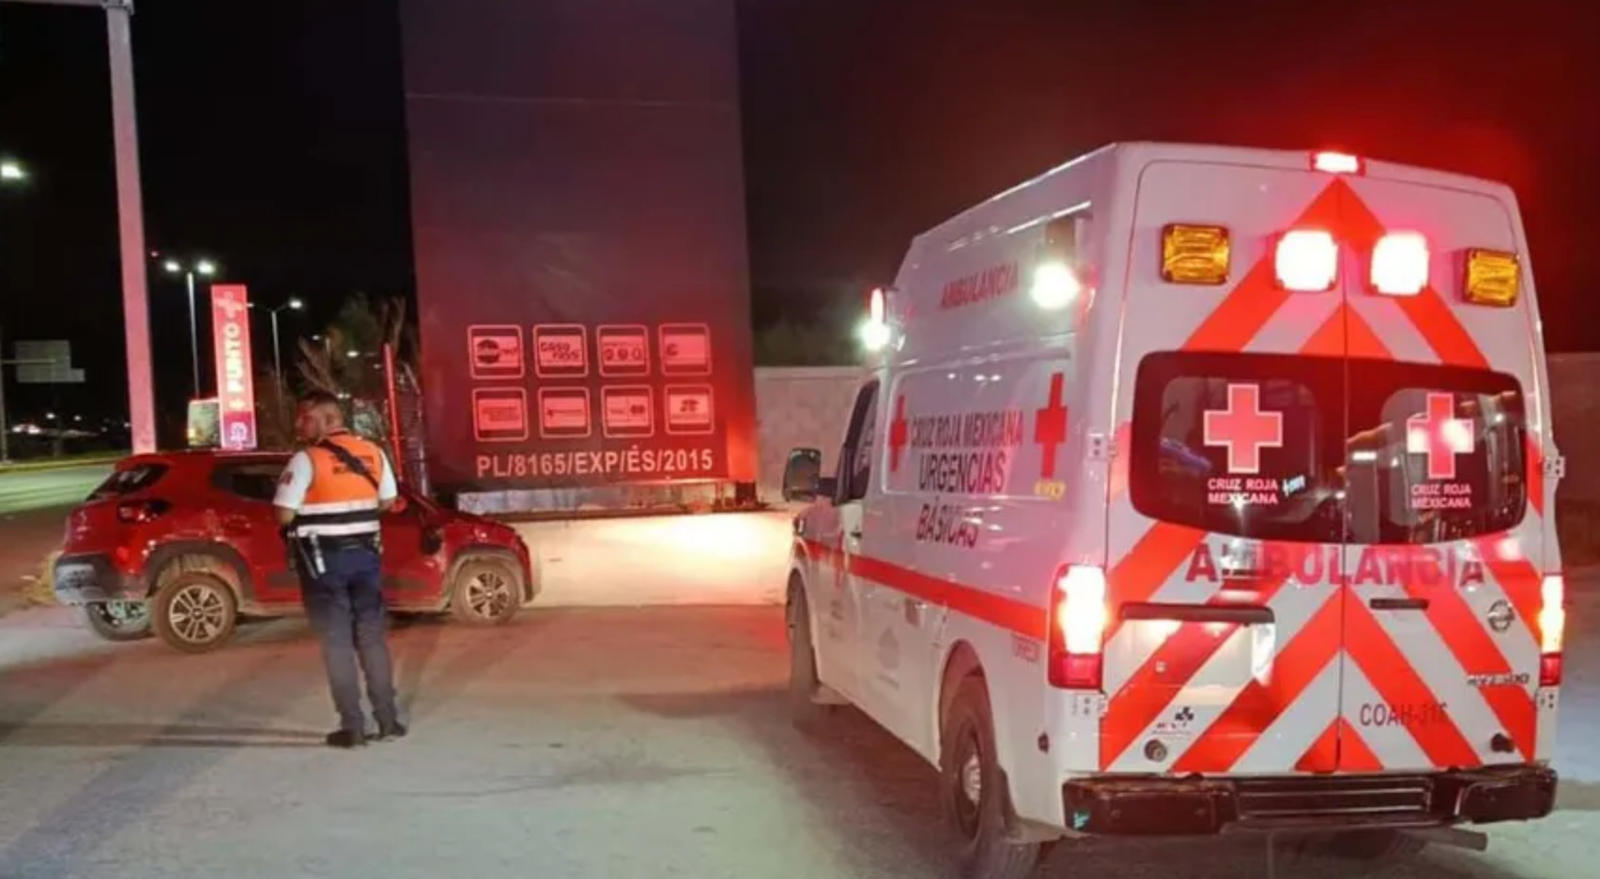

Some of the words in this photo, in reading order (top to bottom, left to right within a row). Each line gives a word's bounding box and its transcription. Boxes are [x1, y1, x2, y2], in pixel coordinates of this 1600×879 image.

[223, 321, 245, 394] PUNTO
[935, 413, 962, 448] ROJA
[919, 452, 1006, 494] URGENCIAS
[1207, 478, 1242, 491] CRUZ
[1245, 478, 1279, 491] ROJA
[1411, 483, 1440, 496] CRUZ
[1443, 483, 1472, 495] ROJA
[1207, 493, 1279, 505] MEXICANA
[1411, 497, 1472, 509] MEXICANA
